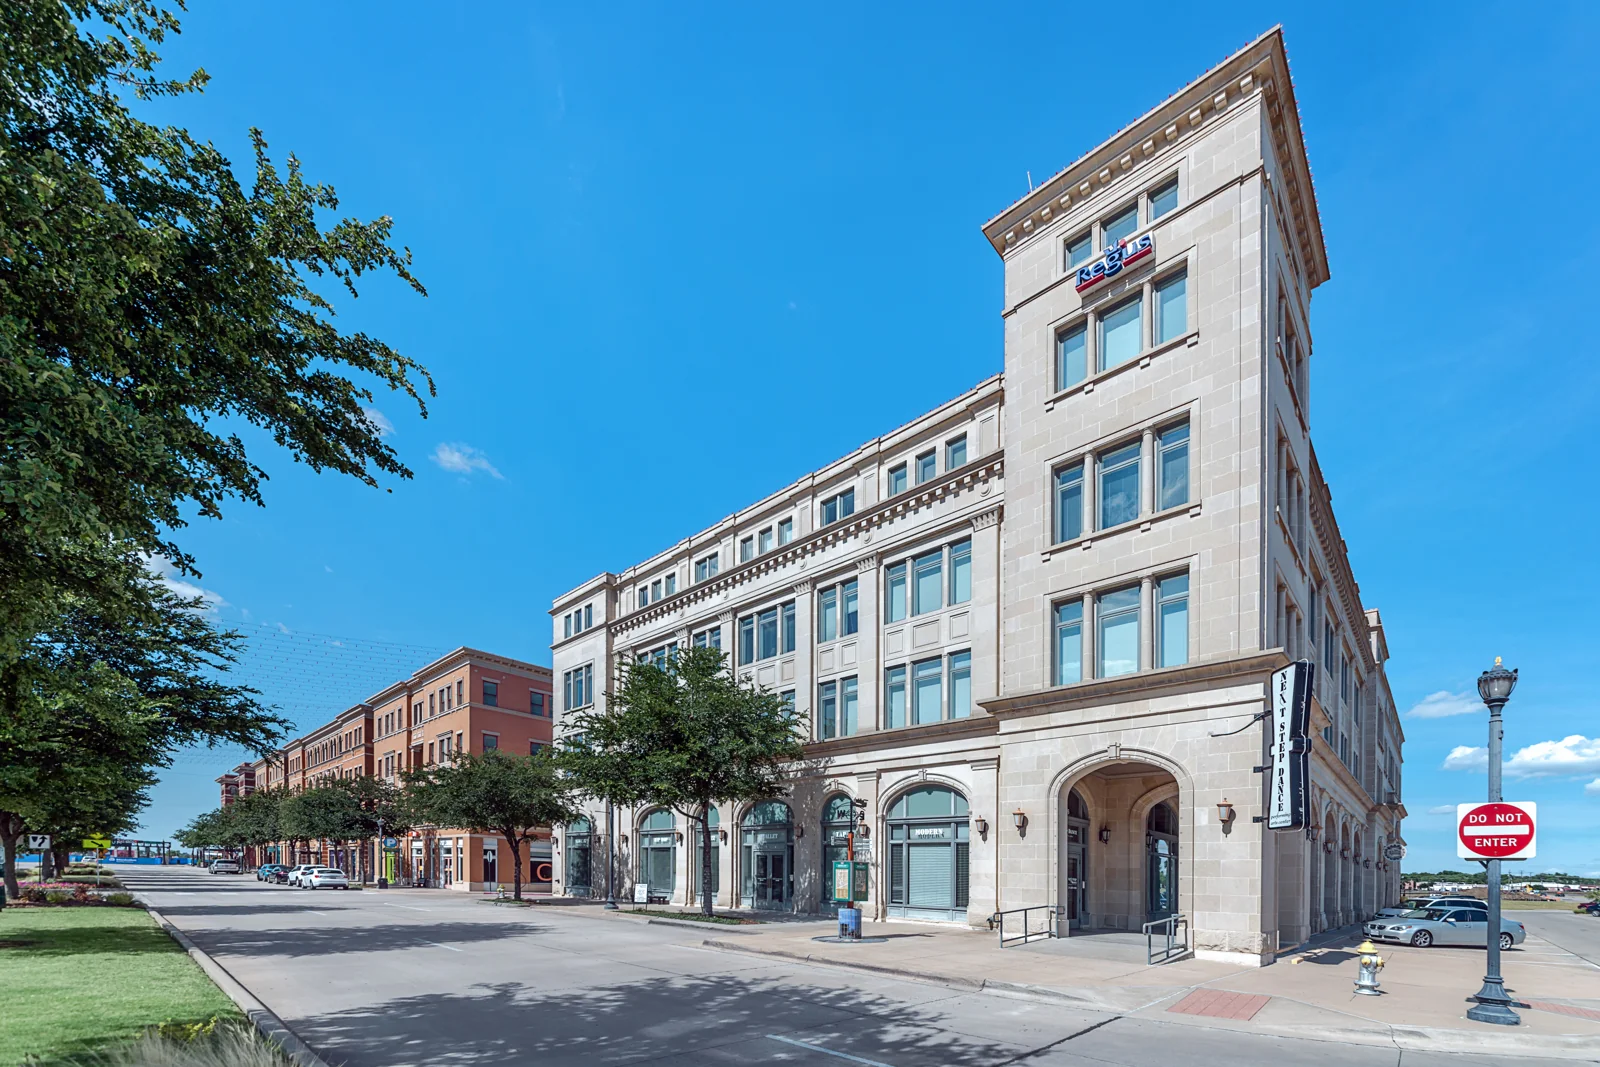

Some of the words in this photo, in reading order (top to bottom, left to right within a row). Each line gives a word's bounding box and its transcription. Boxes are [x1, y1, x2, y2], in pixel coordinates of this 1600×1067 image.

[1075, 233, 1152, 287] Regus
[1279, 671, 1288, 718] NEXT
[1469, 814, 1487, 823] DO
[1495, 813, 1523, 822] NOT
[915, 828, 944, 836] MODERN
[1475, 838, 1517, 847] ENTER
